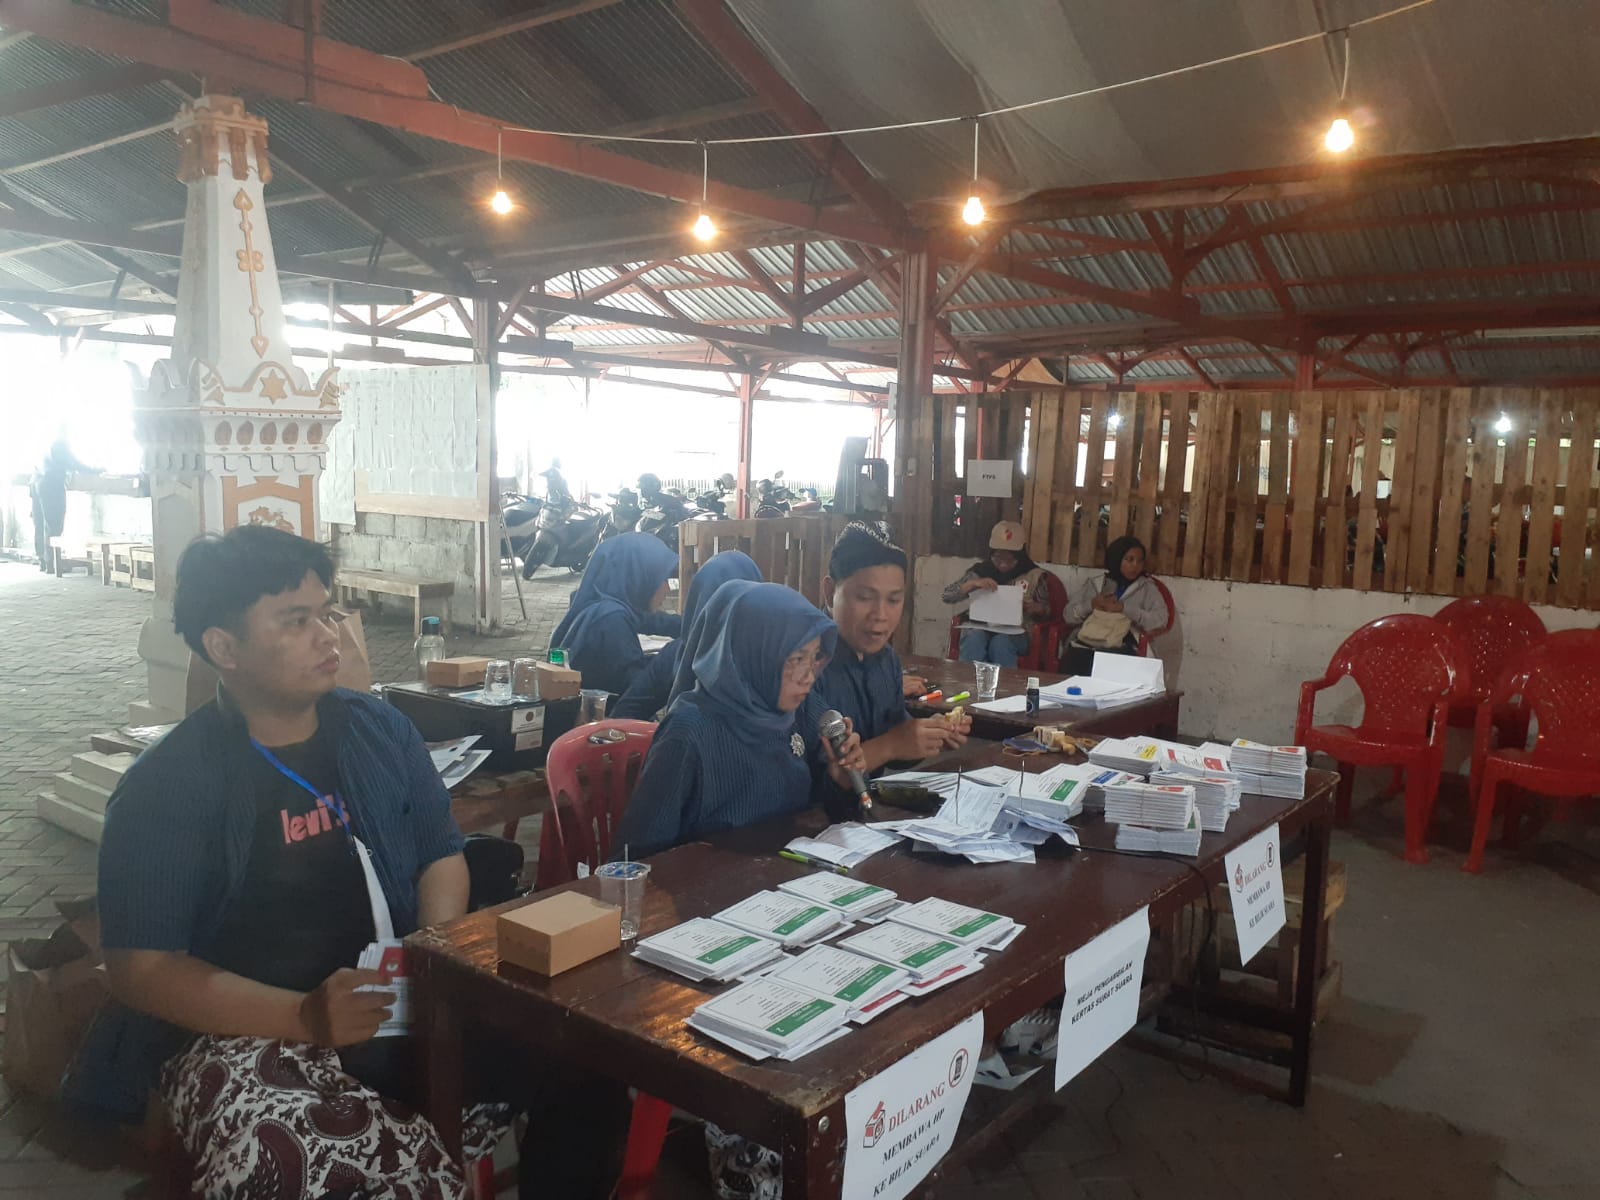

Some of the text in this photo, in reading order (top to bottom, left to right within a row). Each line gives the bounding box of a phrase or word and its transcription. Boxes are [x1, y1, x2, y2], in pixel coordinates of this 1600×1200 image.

[1071, 973, 1133, 1025] KERTAS SURAT SUARA
[1077, 989, 1093, 1005] MEJA
[888, 1081, 946, 1133] DILARANG
[872, 1132, 940, 1198] KE BILIK SUARA
[882, 1118, 931, 1165] MEMBAWA
